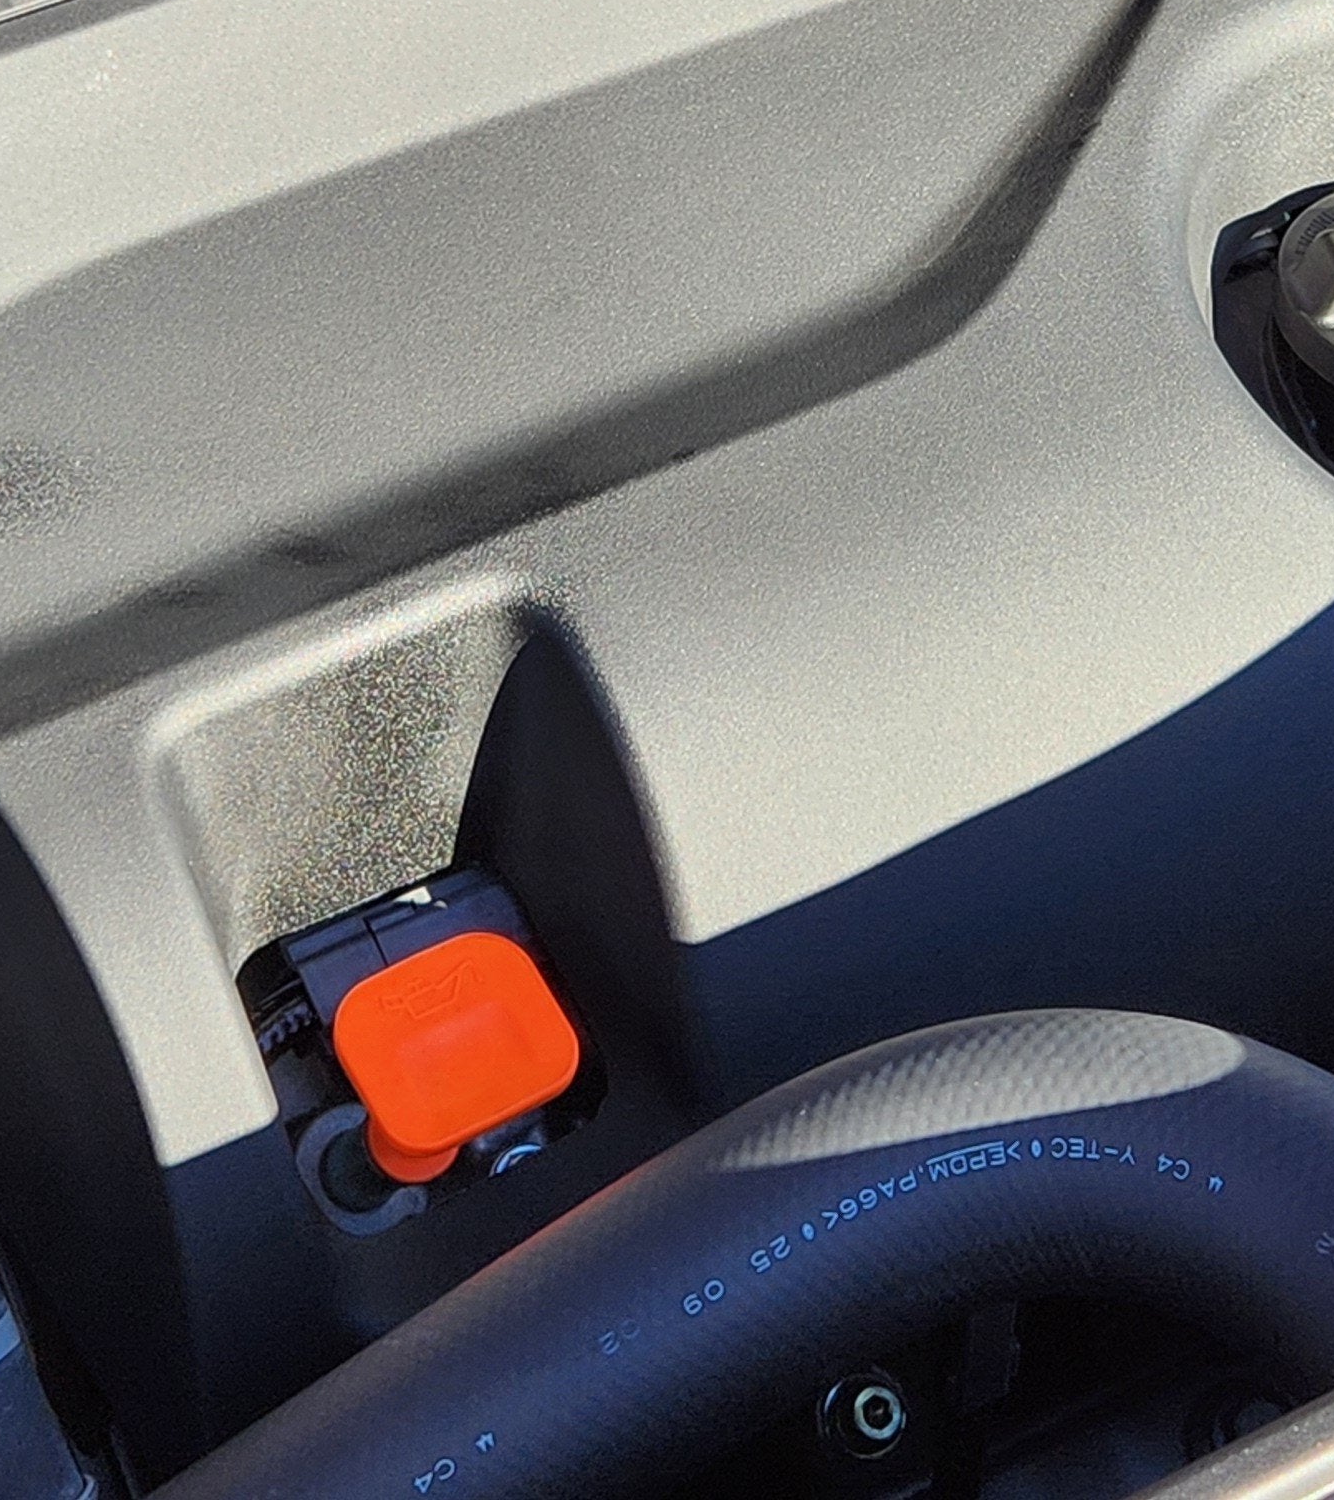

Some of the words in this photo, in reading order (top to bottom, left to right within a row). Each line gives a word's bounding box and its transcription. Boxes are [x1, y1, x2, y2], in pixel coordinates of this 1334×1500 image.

[1050, 1137, 1136, 1165] Y-TEC
[1157, 1153, 1191, 1180] C4
[750, 1234, 791, 1274] 25
[683, 1279, 725, 1316] 09
[413, 1458, 456, 1494] C4
